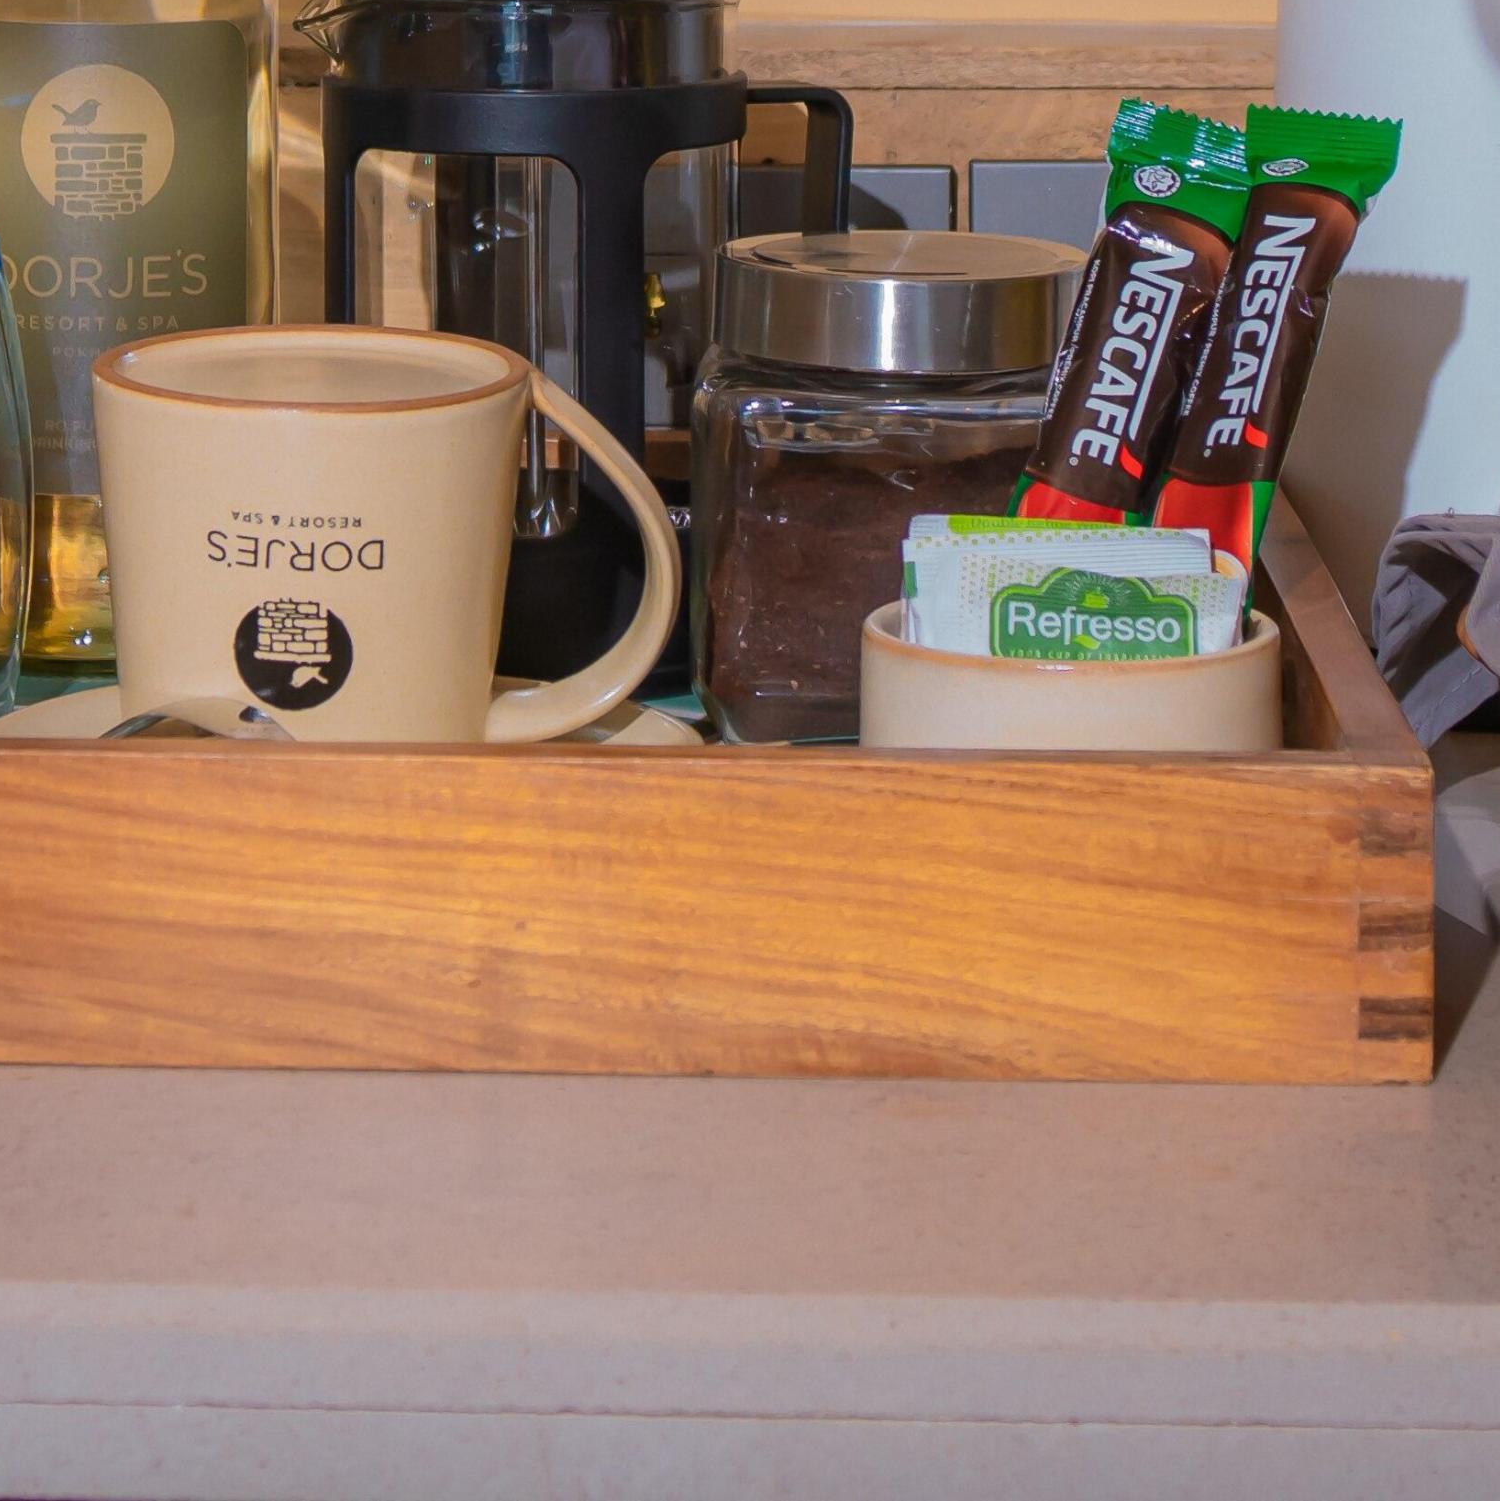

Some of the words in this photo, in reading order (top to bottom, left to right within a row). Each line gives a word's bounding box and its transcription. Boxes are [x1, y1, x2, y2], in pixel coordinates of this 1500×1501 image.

[15, 314, 106, 332] RESORT
[115, 317, 128, 332] &
[137, 314, 180, 331] SPA
[1183, 379, 1200, 417] COFFEE
[231, 511, 264, 525] SPA
[271, 515, 281, 526] &
[288, 516, 362, 529] RESORT
[207, 530, 385, 572] DORJE'S
[1007, 600, 1182, 646] Refresso
[1048, 650, 1071, 660] CUP
